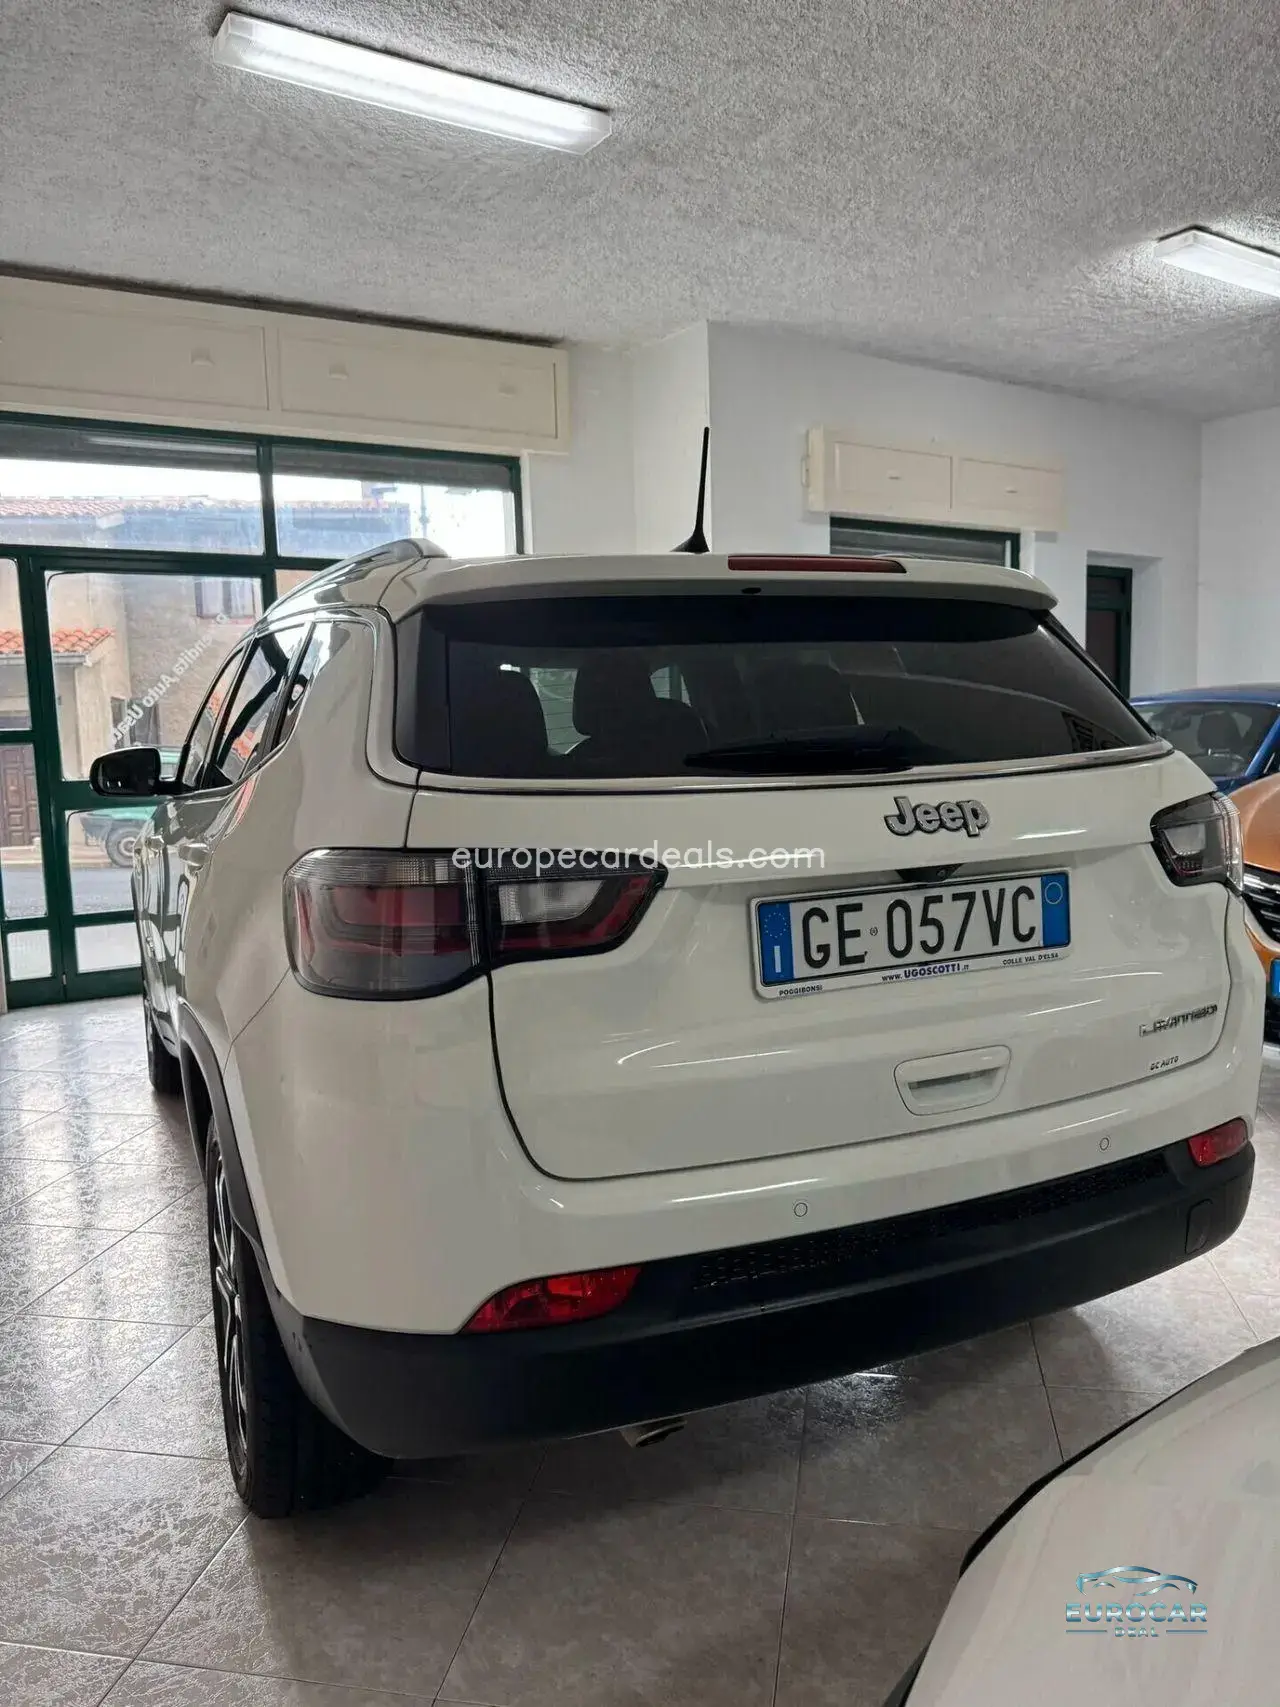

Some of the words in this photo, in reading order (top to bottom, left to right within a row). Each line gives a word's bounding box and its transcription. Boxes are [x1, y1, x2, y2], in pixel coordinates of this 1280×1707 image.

[884, 796, 989, 838] Jeep
[802, 903, 866, 969] GE
[886, 885, 1036, 959] 057VC
[1160, 1055, 1180, 1068] AUTO
